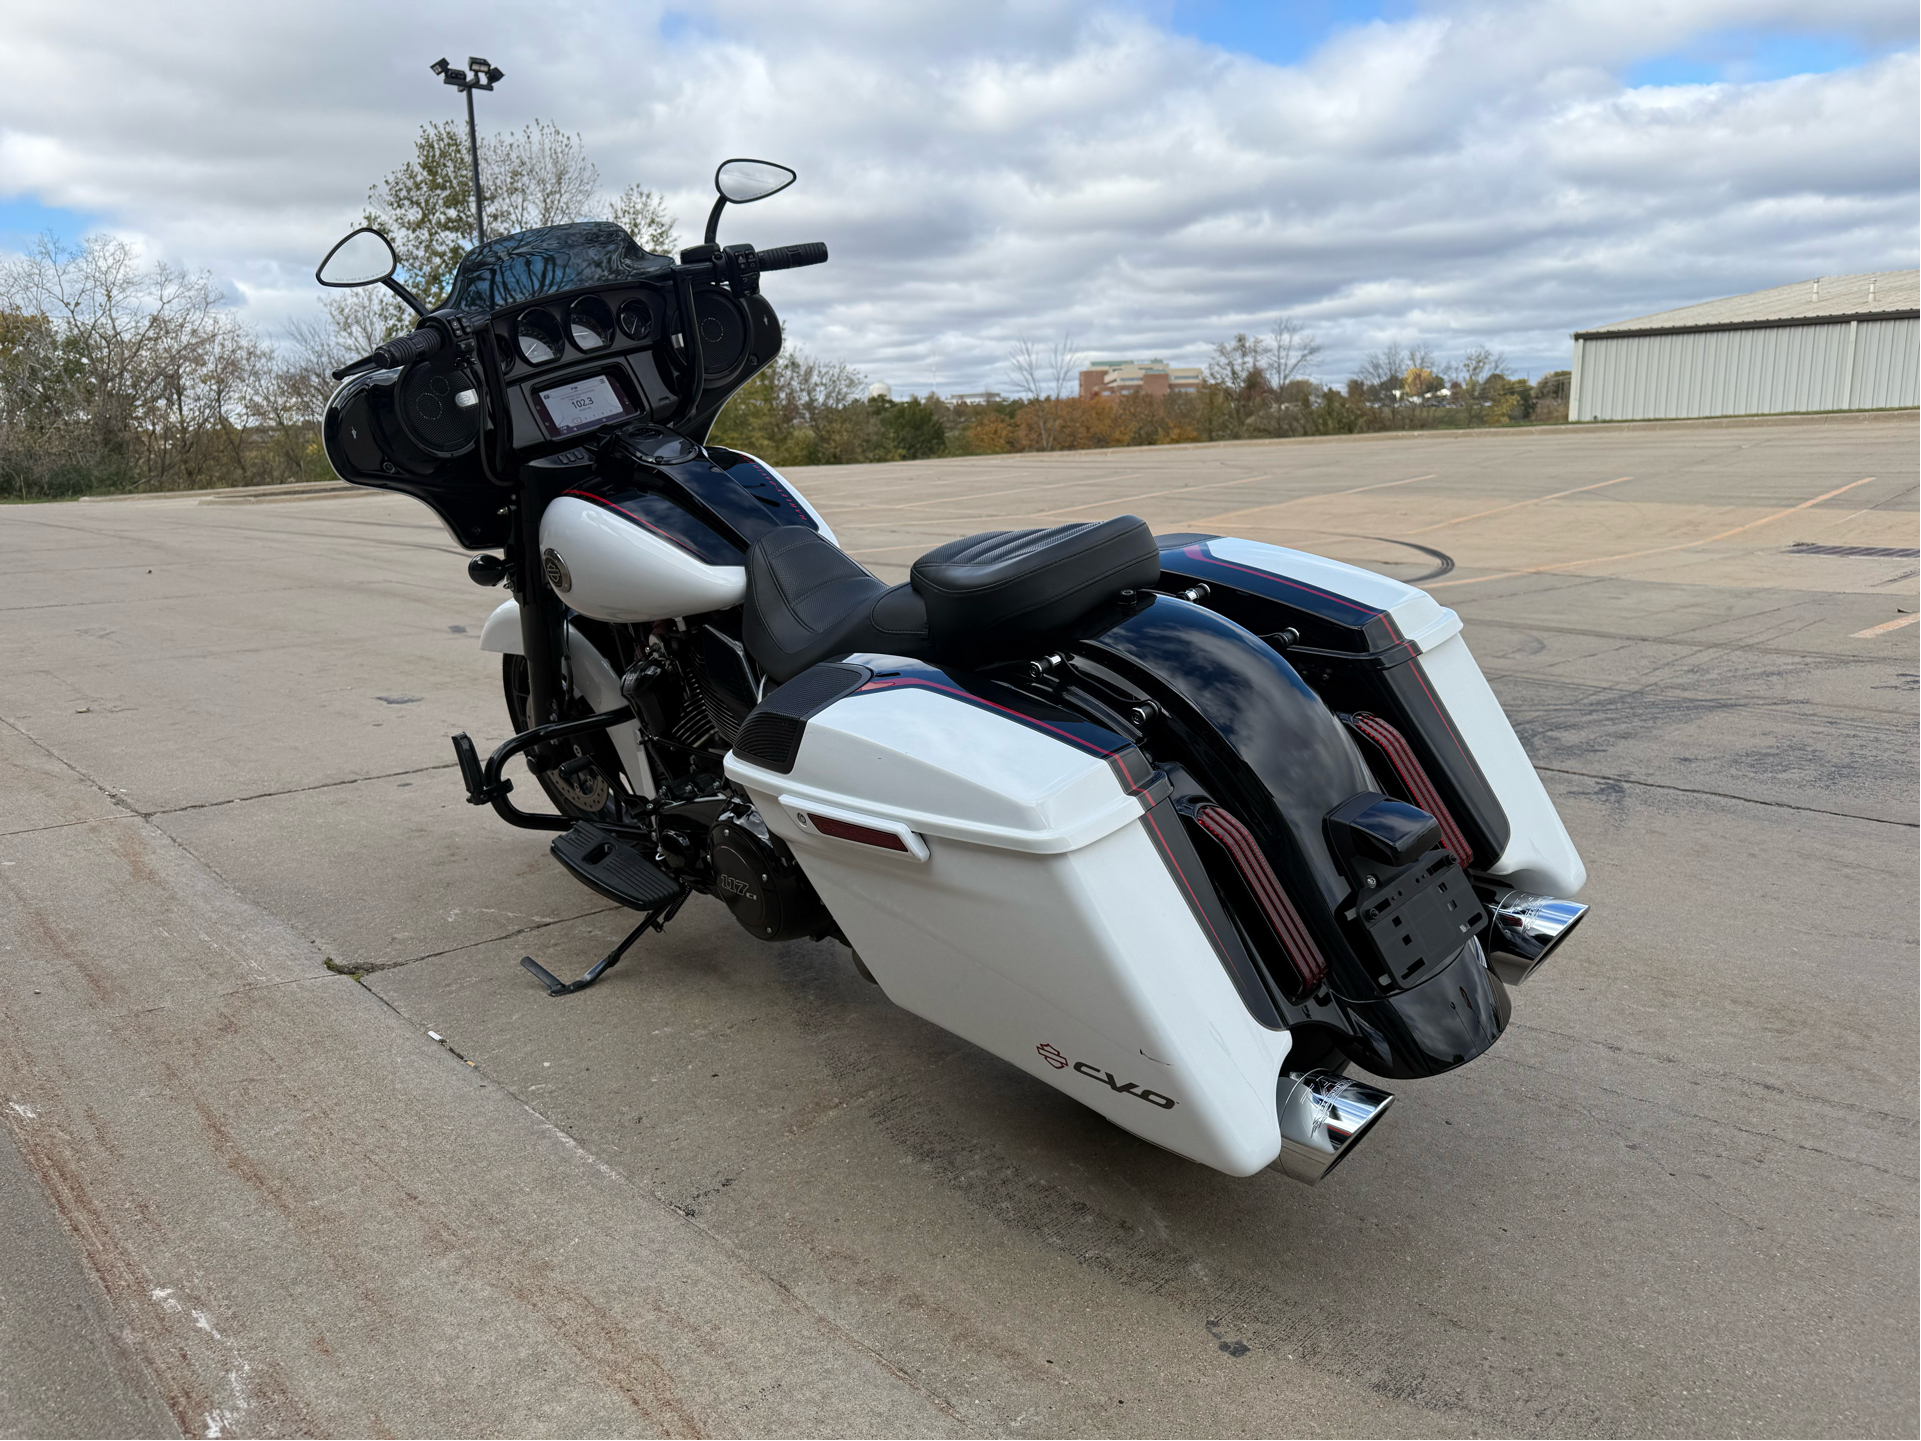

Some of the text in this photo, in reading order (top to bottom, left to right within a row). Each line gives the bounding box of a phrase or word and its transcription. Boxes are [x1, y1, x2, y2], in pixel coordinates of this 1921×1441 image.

[571, 396, 594, 409] 102.3
[721, 874, 749, 896] 117
[1073, 1061, 1176, 1110] CVO
